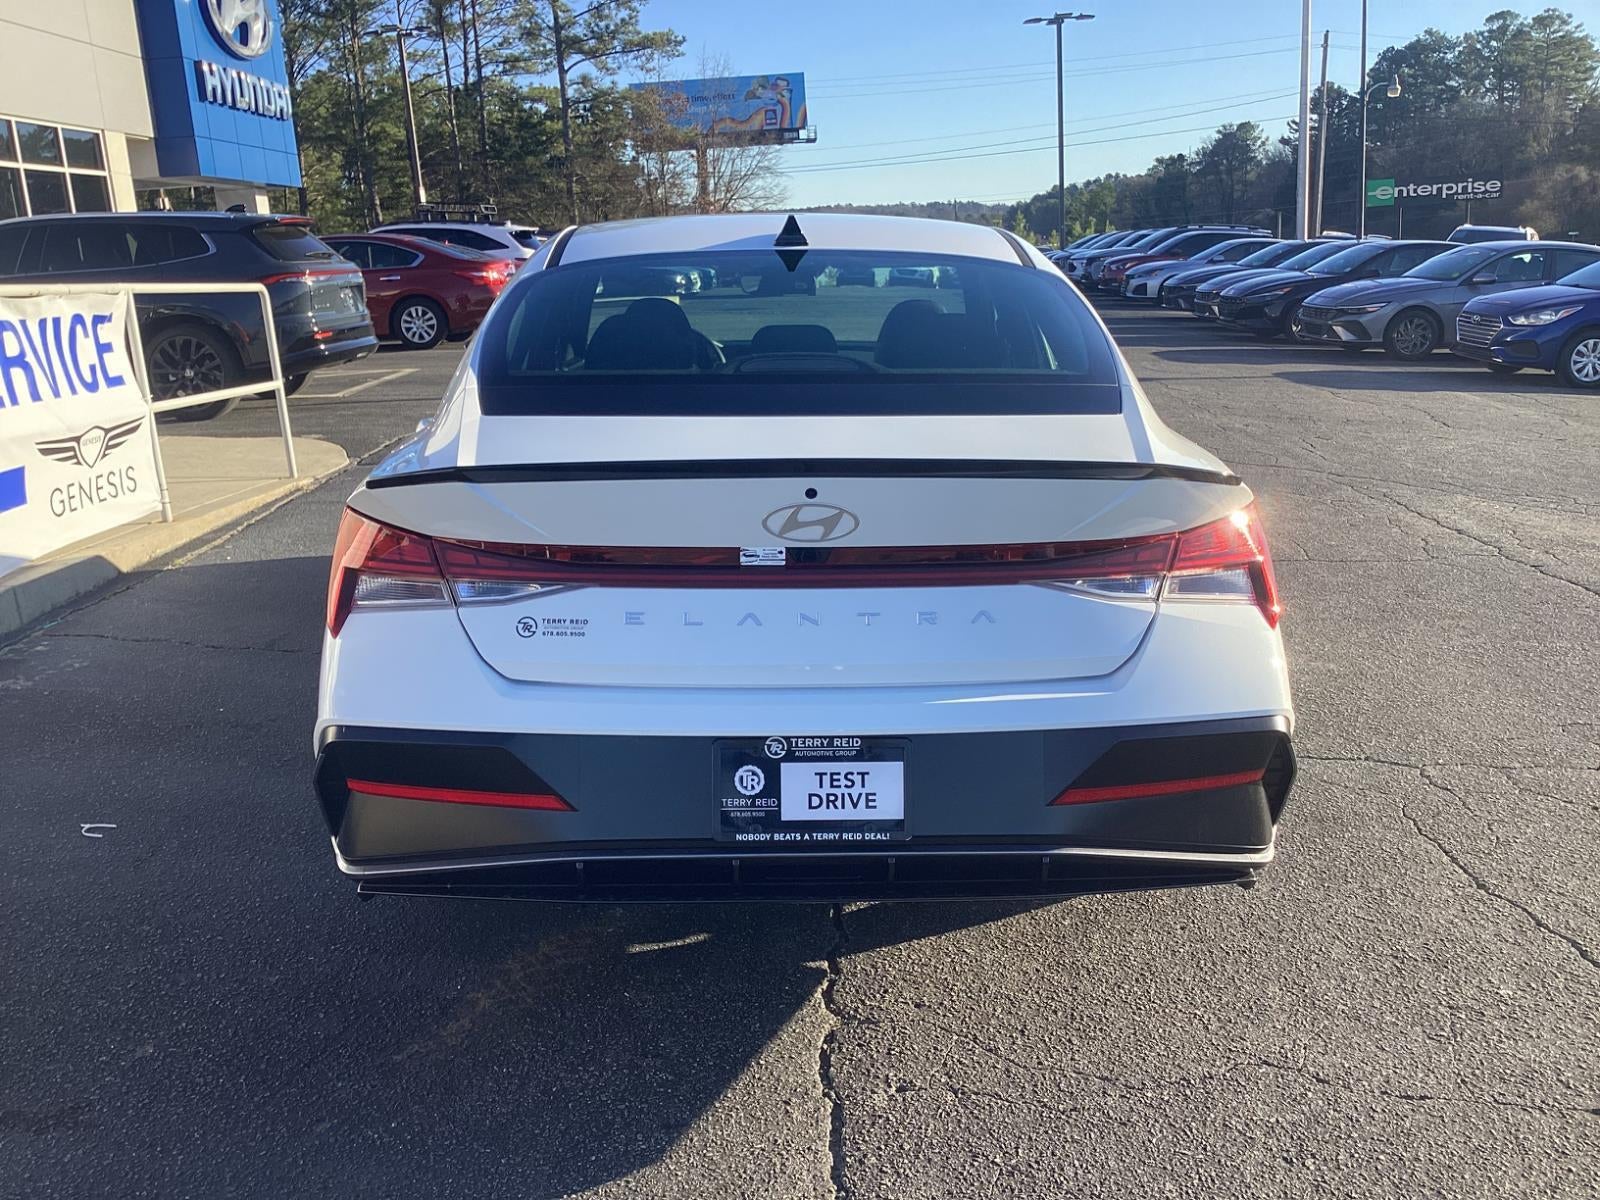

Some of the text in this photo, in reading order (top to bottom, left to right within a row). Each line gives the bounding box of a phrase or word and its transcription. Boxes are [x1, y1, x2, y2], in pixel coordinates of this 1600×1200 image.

[200, 60, 292, 120] HYUNDAI
[1368, 178, 1502, 199] enterprise
[1453, 192, 1501, 200] rent-a-car
[0, 312, 126, 408] RVICE
[50, 465, 137, 517] GENESIS
[624, 610, 996, 626] ELANTRA
[790, 738, 861, 747] TERRY REID
[814, 771, 870, 789] TEST
[721, 798, 778, 807] TERRY REID
[808, 792, 877, 810] DRIVE
[735, 833, 771, 841] NOBODY
[842, 832, 863, 840] REID
[864, 832, 890, 840] DEAL!
